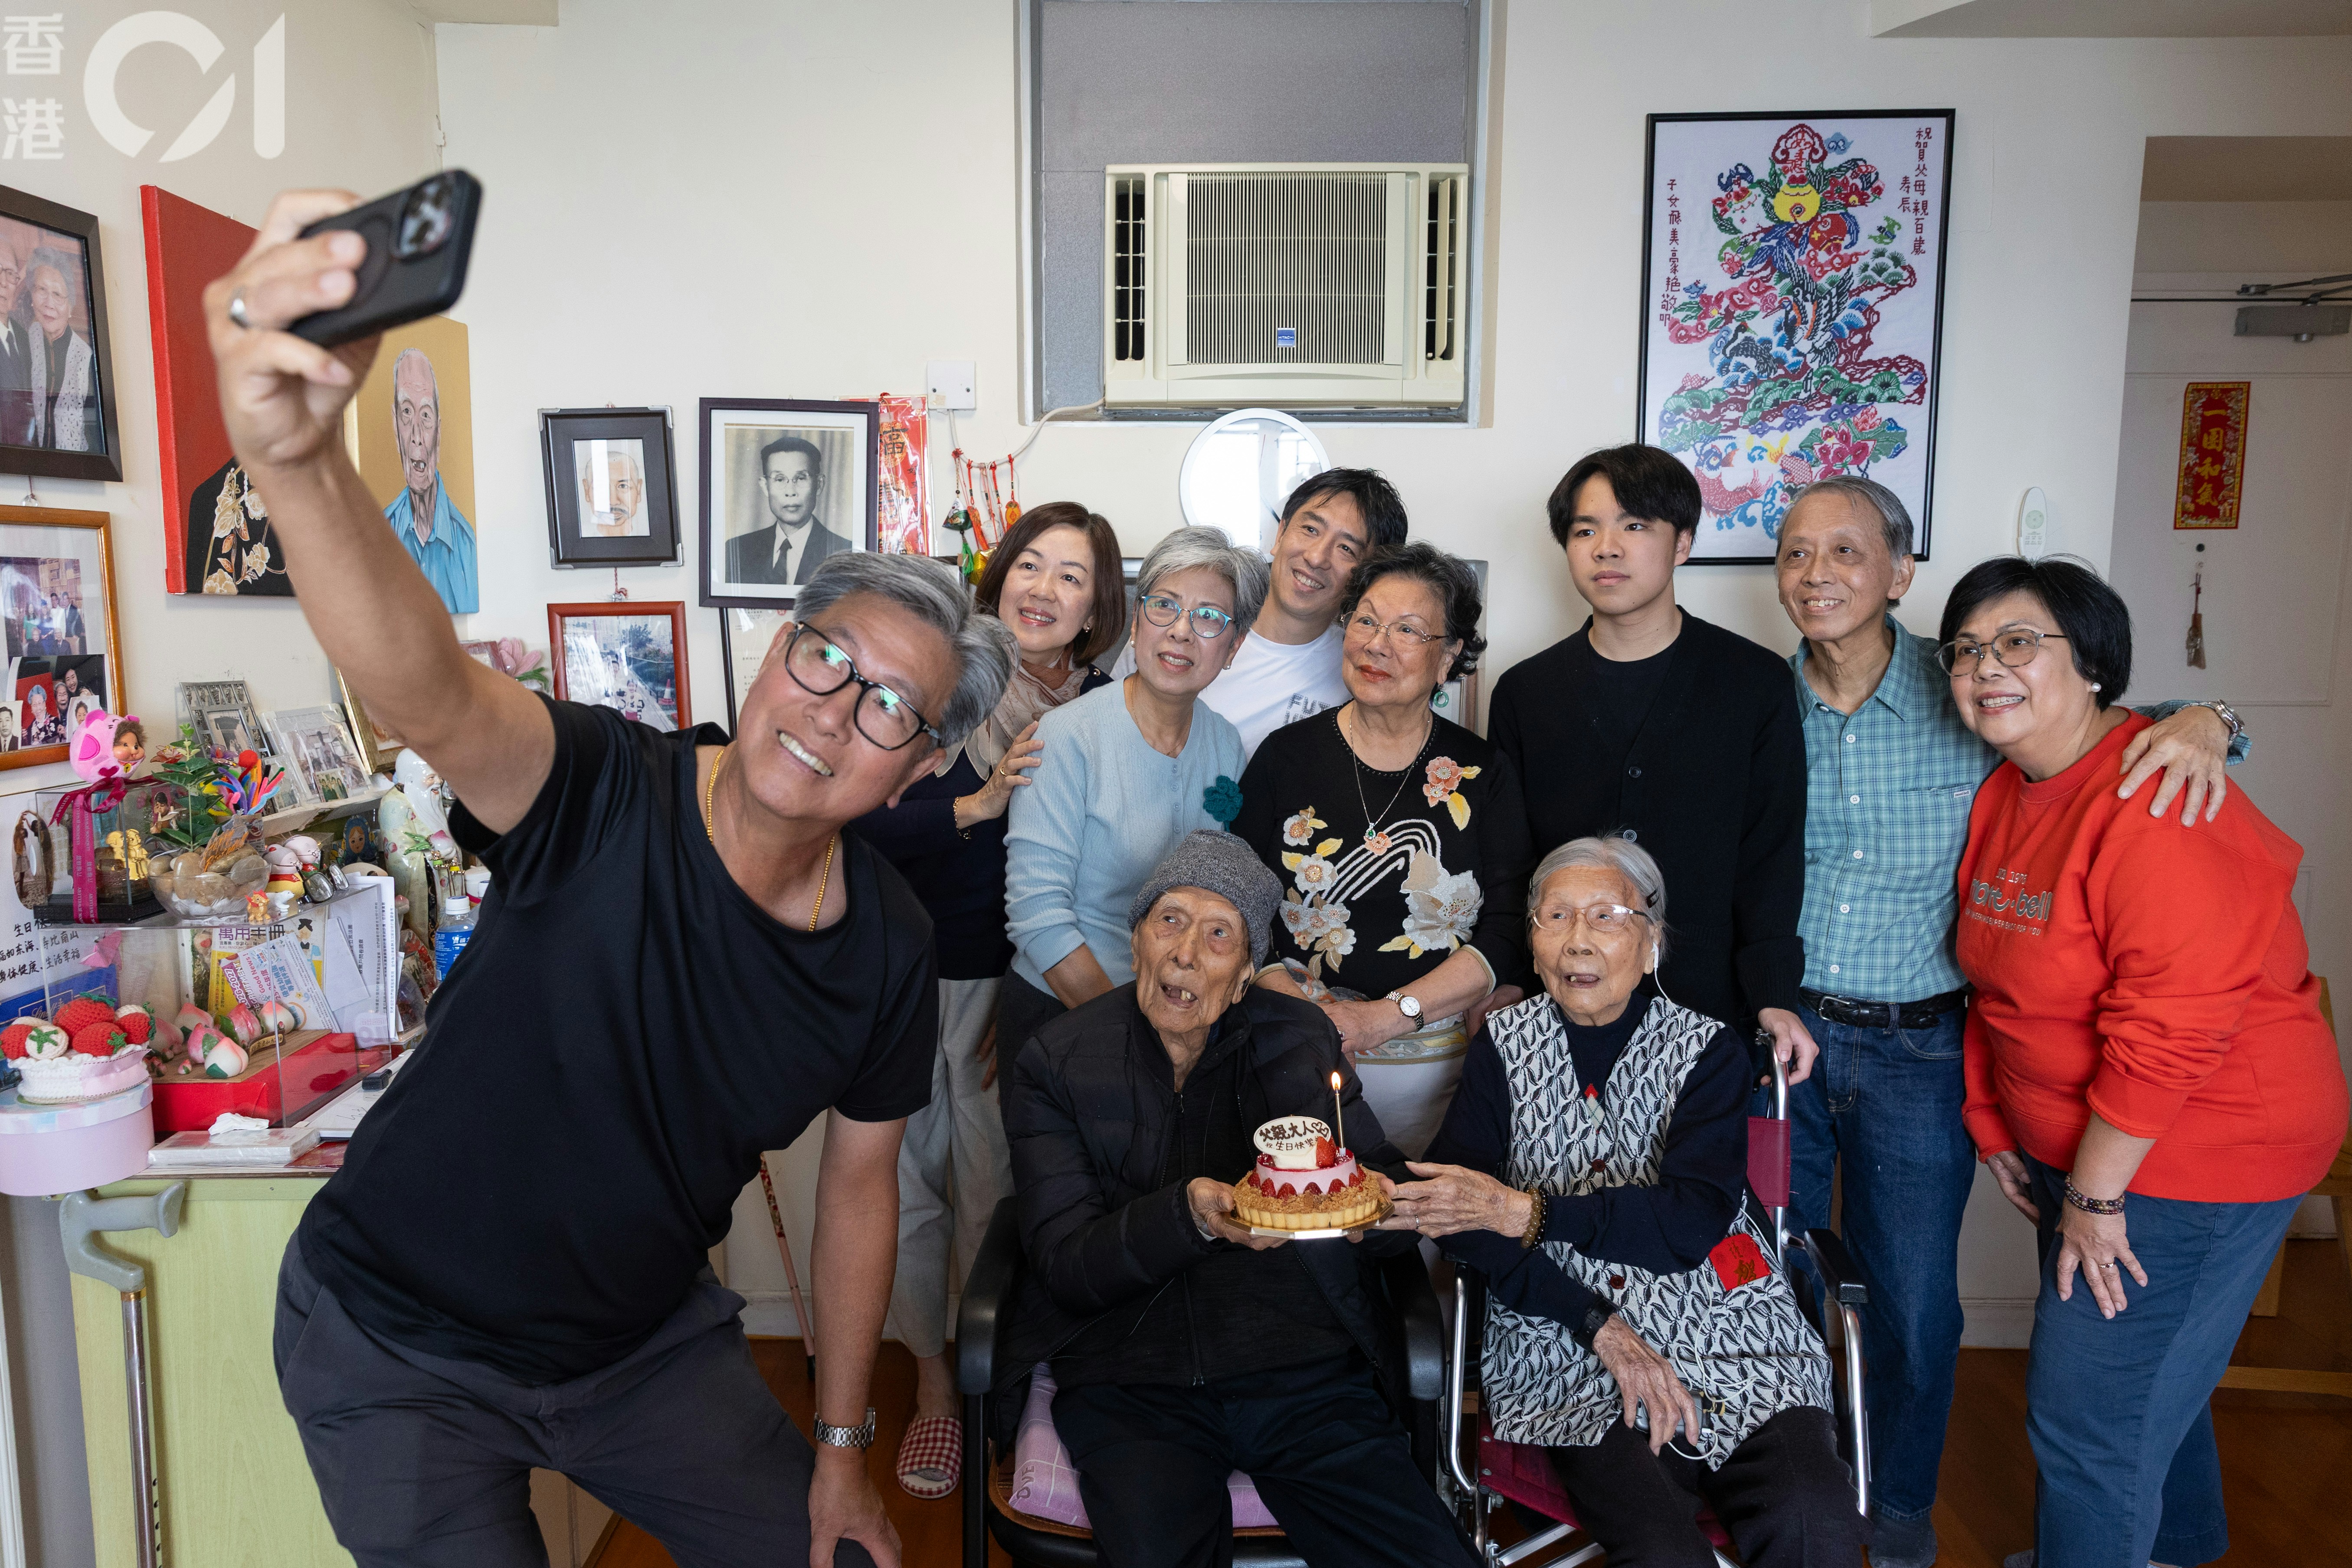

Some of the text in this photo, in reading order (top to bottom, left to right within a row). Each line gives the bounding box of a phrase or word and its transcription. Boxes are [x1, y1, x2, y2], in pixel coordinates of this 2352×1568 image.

[14, 918, 50, 937] 生日快
[254, 976, 265, 993] Good
[1259, 1121, 1314, 1142] 父親大人
